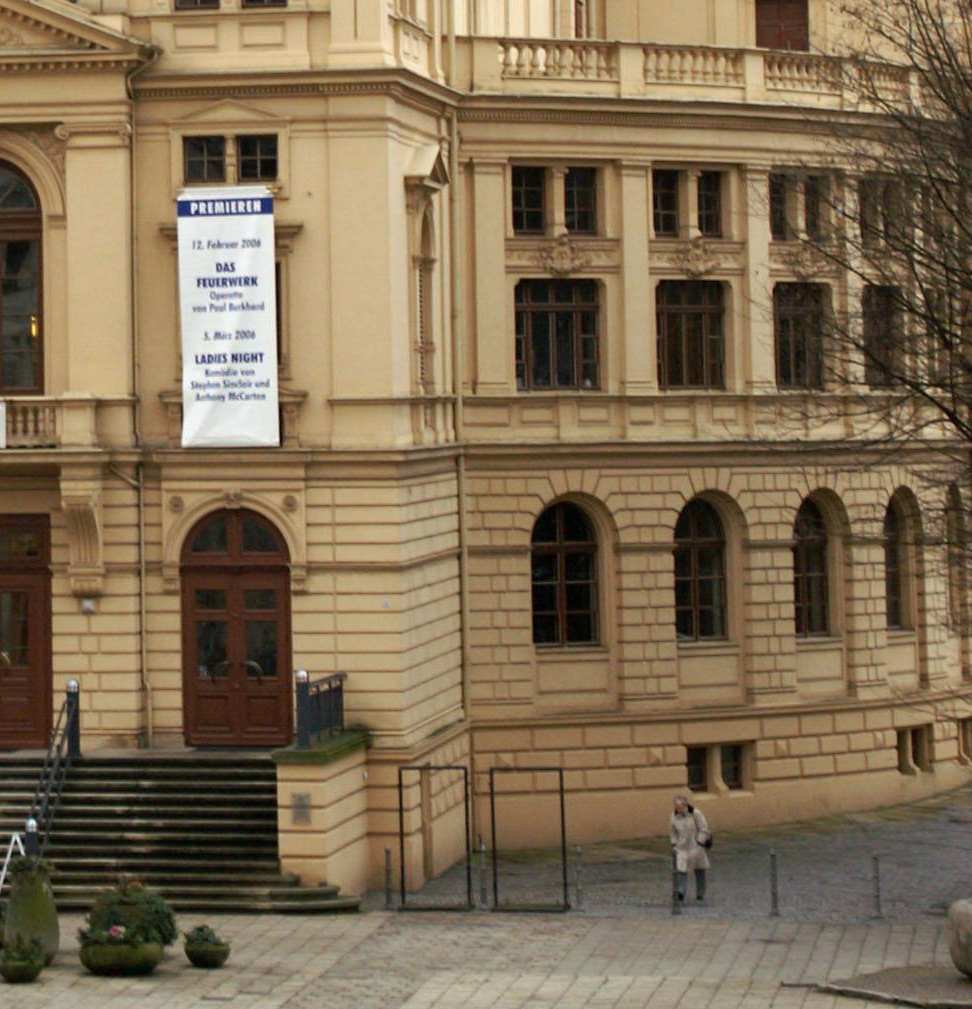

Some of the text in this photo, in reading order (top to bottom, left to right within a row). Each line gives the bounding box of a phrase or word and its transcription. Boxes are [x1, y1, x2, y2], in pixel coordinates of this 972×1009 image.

[190, 200, 262, 215] PREMIEREN
[192, 238, 261, 250] 12. Februar 2006
[215, 262, 236, 272] DAS
[196, 277, 259, 288] FEUERWERK
[209, 291, 243, 301] Operette
[209, 302, 226, 312] Paul
[229, 301, 265, 311] Burkhard
[235, 330, 256, 340] 2006
[195, 352, 264, 364] LADIES NIGHT
[204, 368, 238, 377] Komödie
[254, 379, 270, 388] und
[228, 392, 266, 401] McCarten
